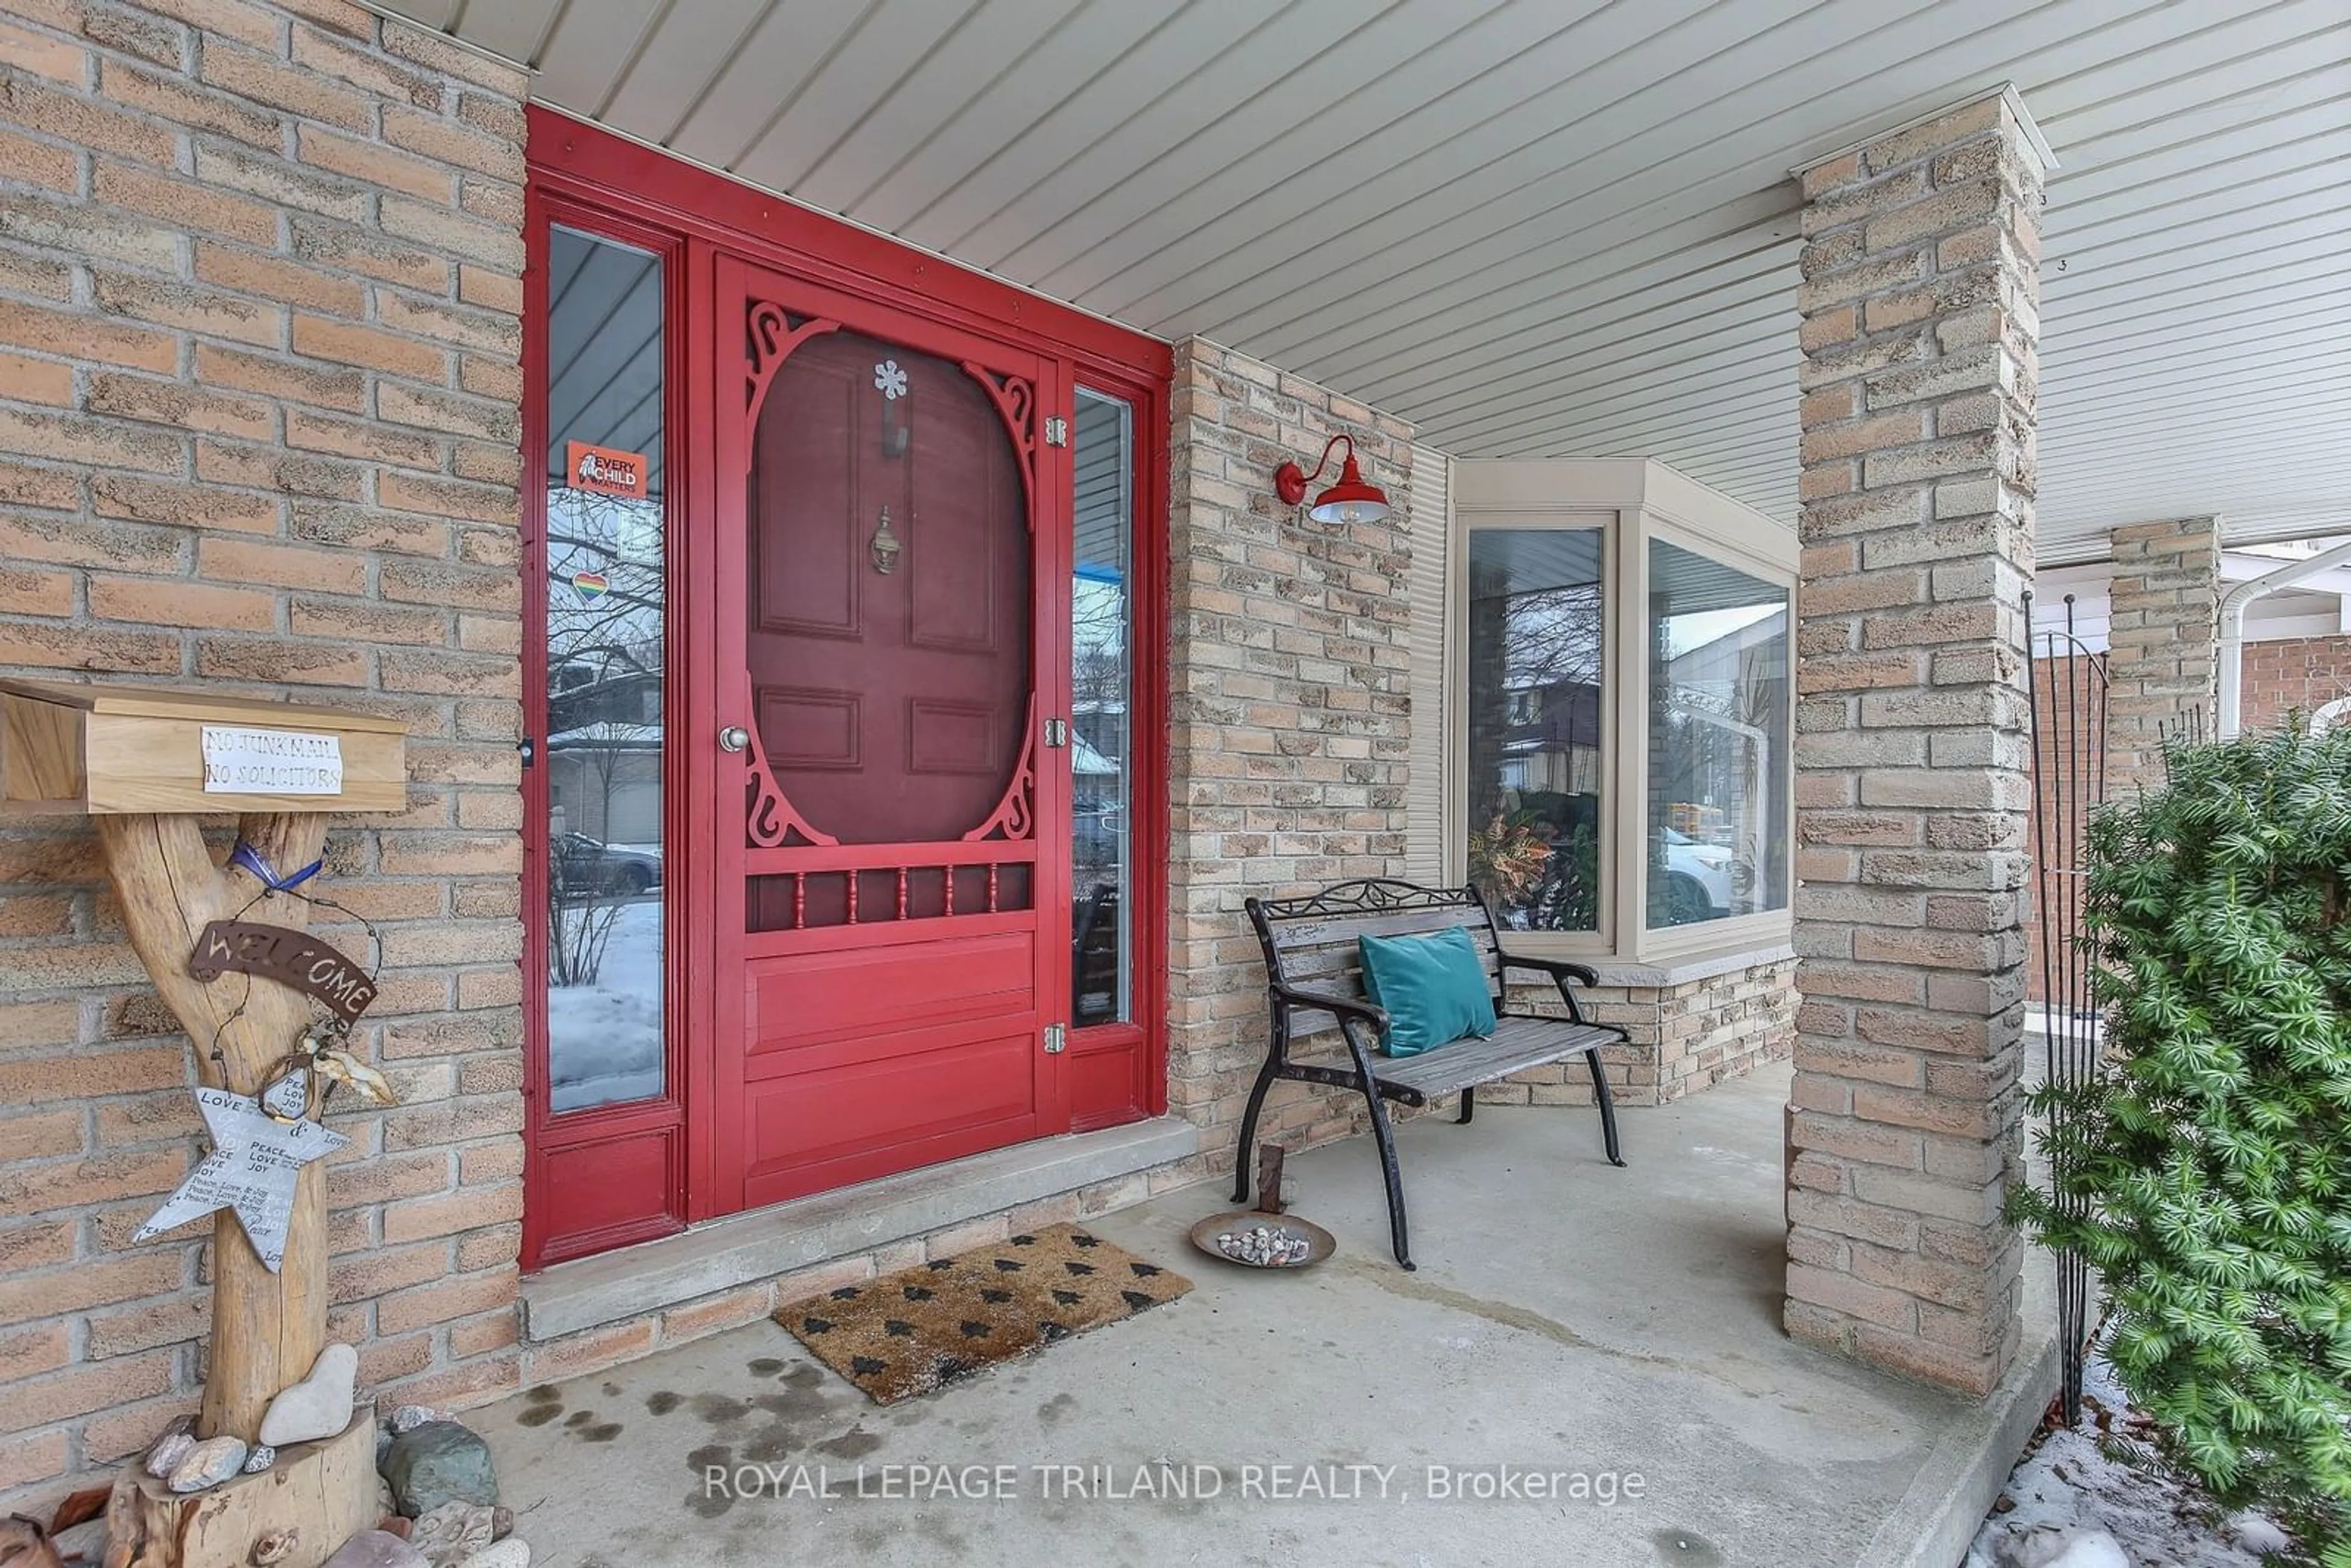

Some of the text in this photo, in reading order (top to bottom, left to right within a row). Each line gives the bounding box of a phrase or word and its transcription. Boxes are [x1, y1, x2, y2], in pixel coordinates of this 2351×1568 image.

[594, 456, 636, 473] EVERY
[594, 467, 636, 485] CHILD
[206, 731, 233, 751] NO
[206, 764, 340, 787] NO SOLICITORS
[208, 929, 372, 1014] WELCOME
[201, 1092, 242, 1112] LOVE
[282, 1098, 302, 1108] JOY
[250, 1141, 286, 1157] PEACE
[249, 1152, 278, 1165] LOVE
[247, 1163, 269, 1174] JOY
